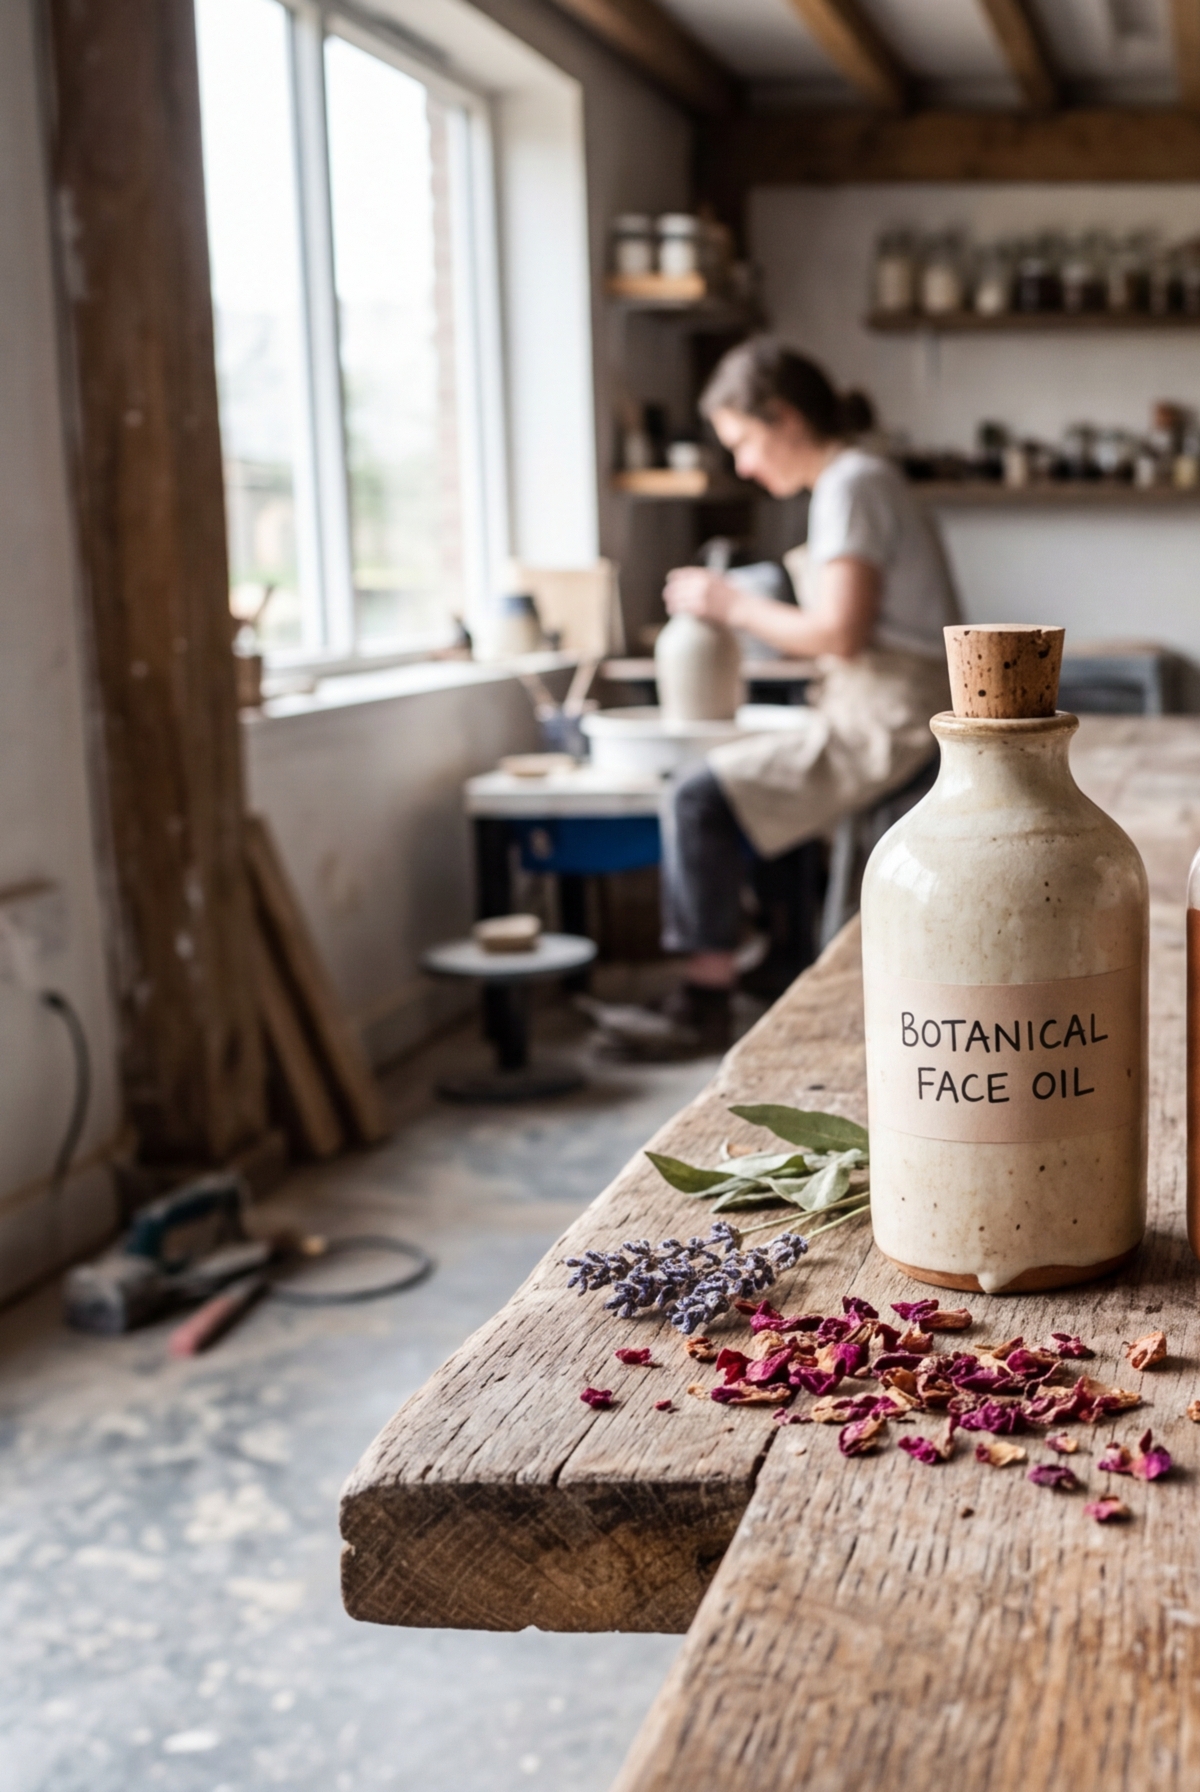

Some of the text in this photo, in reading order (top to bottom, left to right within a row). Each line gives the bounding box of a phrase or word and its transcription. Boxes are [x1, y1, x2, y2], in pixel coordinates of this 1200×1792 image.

[901, 1011, 1109, 1053] BOTANICAL
[917, 1066, 1096, 1104] FACE OIL
